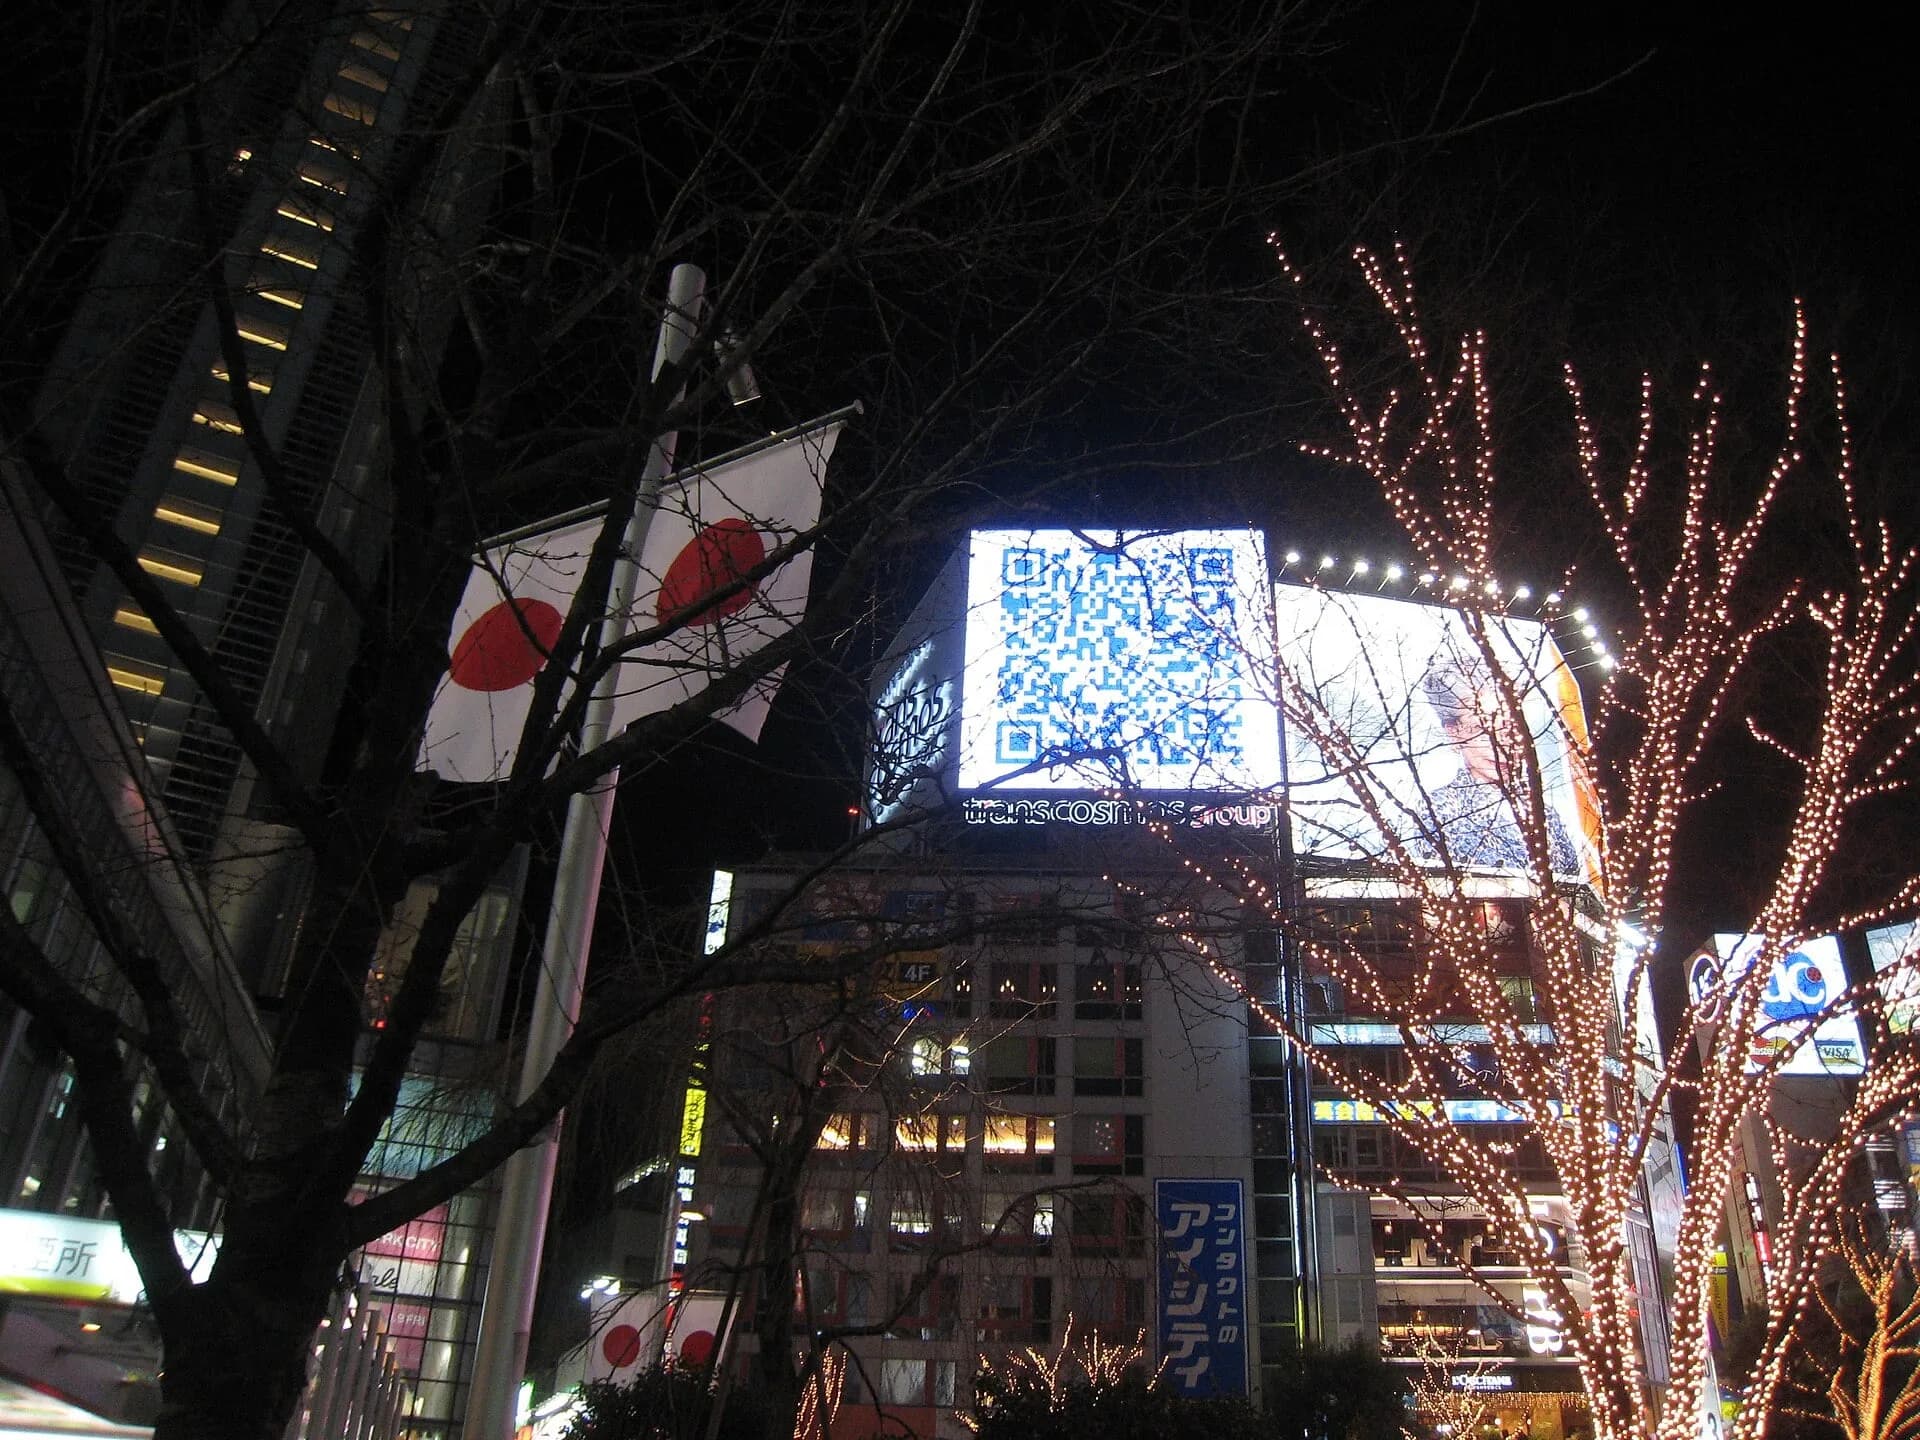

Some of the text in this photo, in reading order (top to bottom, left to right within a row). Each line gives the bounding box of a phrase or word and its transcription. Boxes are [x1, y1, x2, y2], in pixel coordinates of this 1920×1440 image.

[1190, 804, 1273, 830] group
[903, 964, 931, 981] 4F
[1823, 1046, 1853, 1060] VISA
[1213, 1203, 1240, 1345] コンタクトの
[1163, 1202, 1212, 1389] アイシティ
